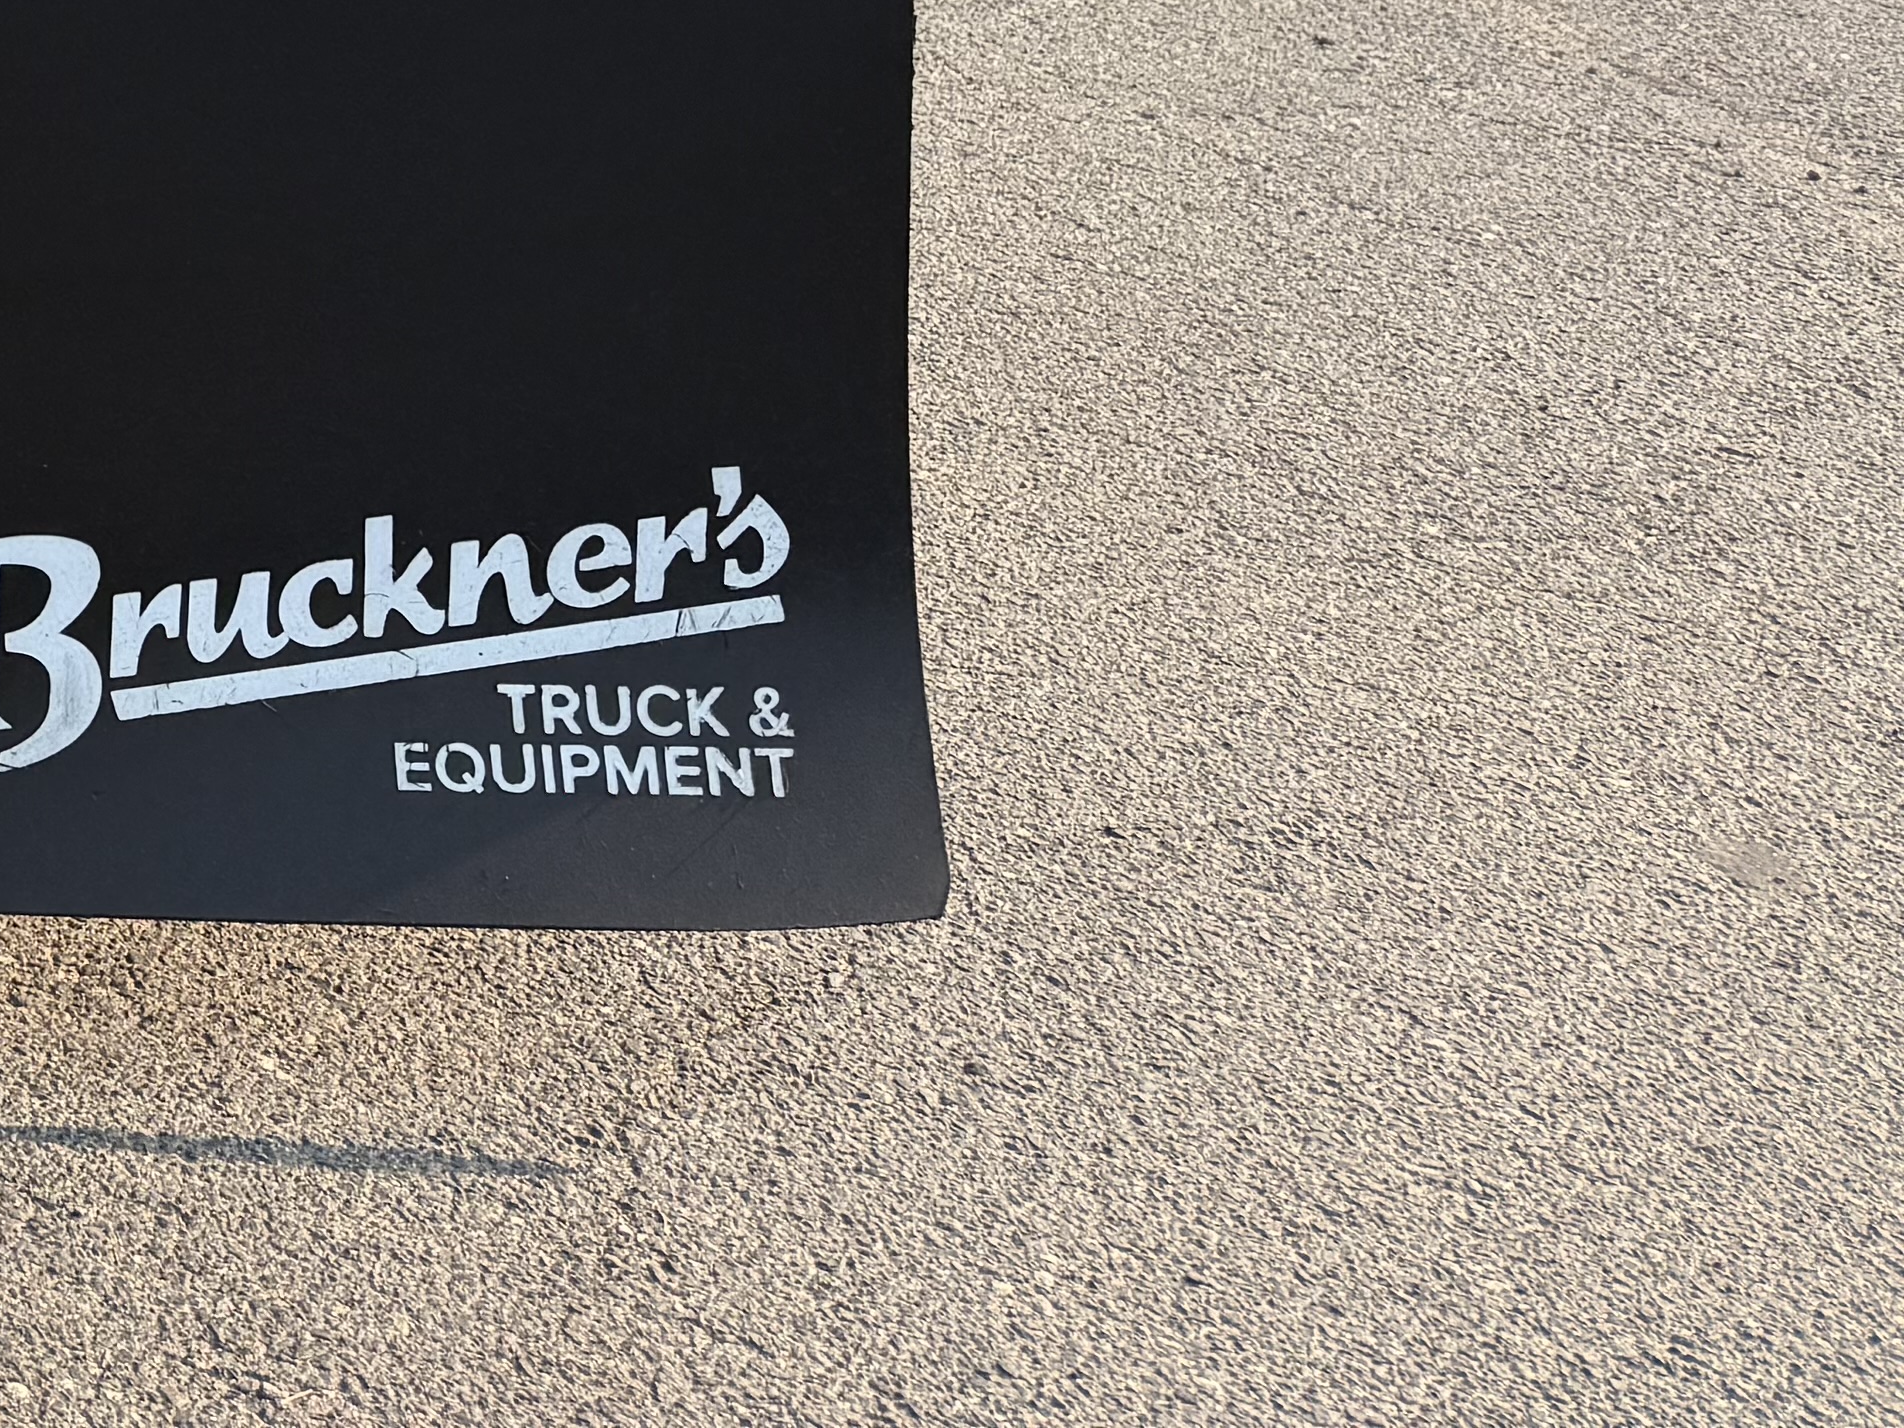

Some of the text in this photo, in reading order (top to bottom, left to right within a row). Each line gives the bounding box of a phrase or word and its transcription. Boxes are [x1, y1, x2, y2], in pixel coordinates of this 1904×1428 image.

[496, 683, 795, 738] TRUCK &
[395, 742, 794, 798] EQUIPMENT
